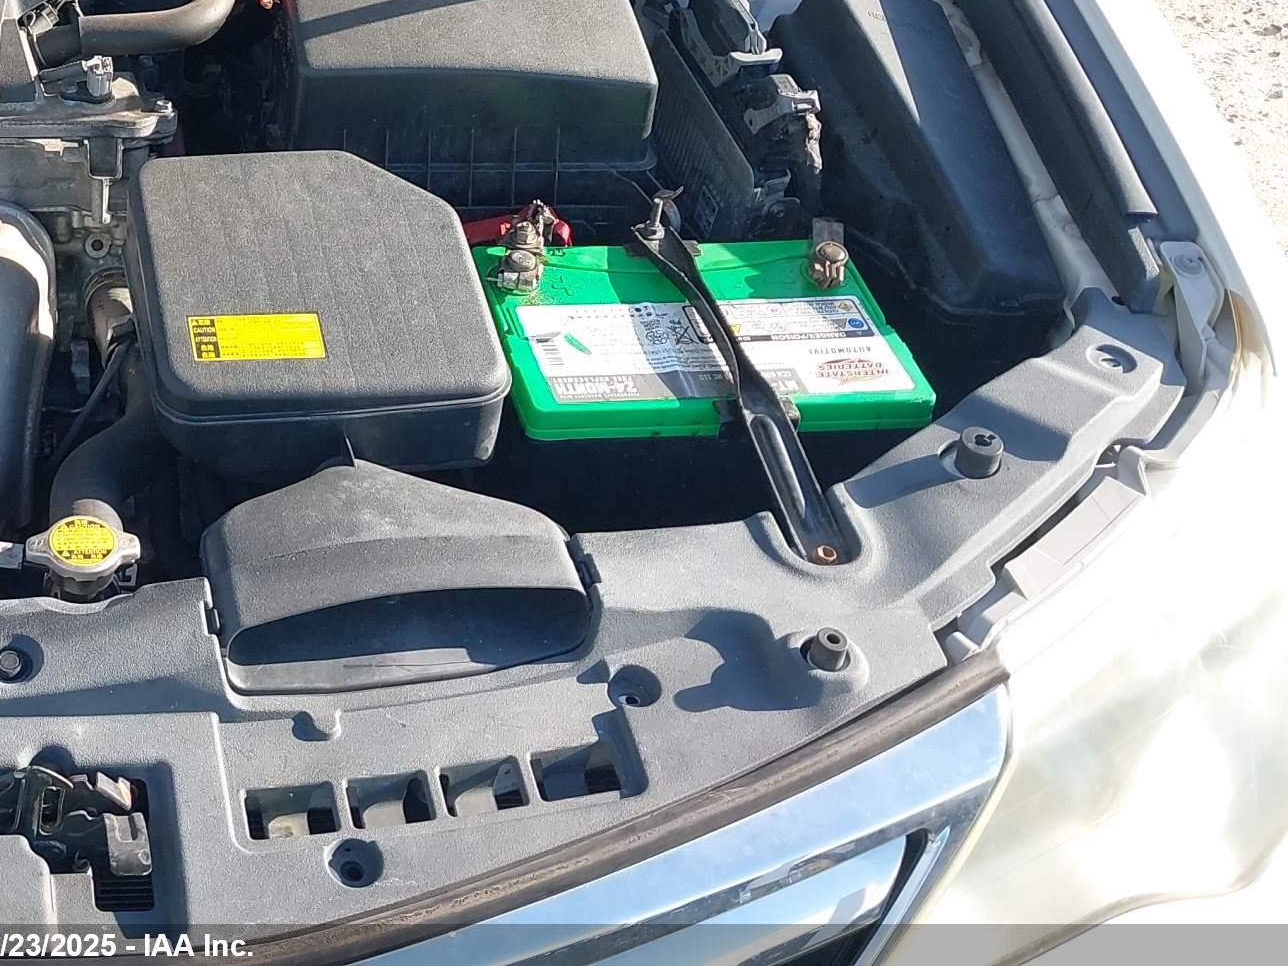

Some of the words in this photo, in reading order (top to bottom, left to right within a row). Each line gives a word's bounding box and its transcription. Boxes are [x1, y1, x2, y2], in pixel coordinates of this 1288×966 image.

[770, 332, 847, 341] DANGER/POISON
[808, 346, 872, 355] AUTOMOTIVE
[816, 361, 883, 371] BATTERIES
[815, 369, 889, 379] INTERSTATE
[553, 382, 638, 396] 24-MONTH
[770, 379, 801, 392] MT-
